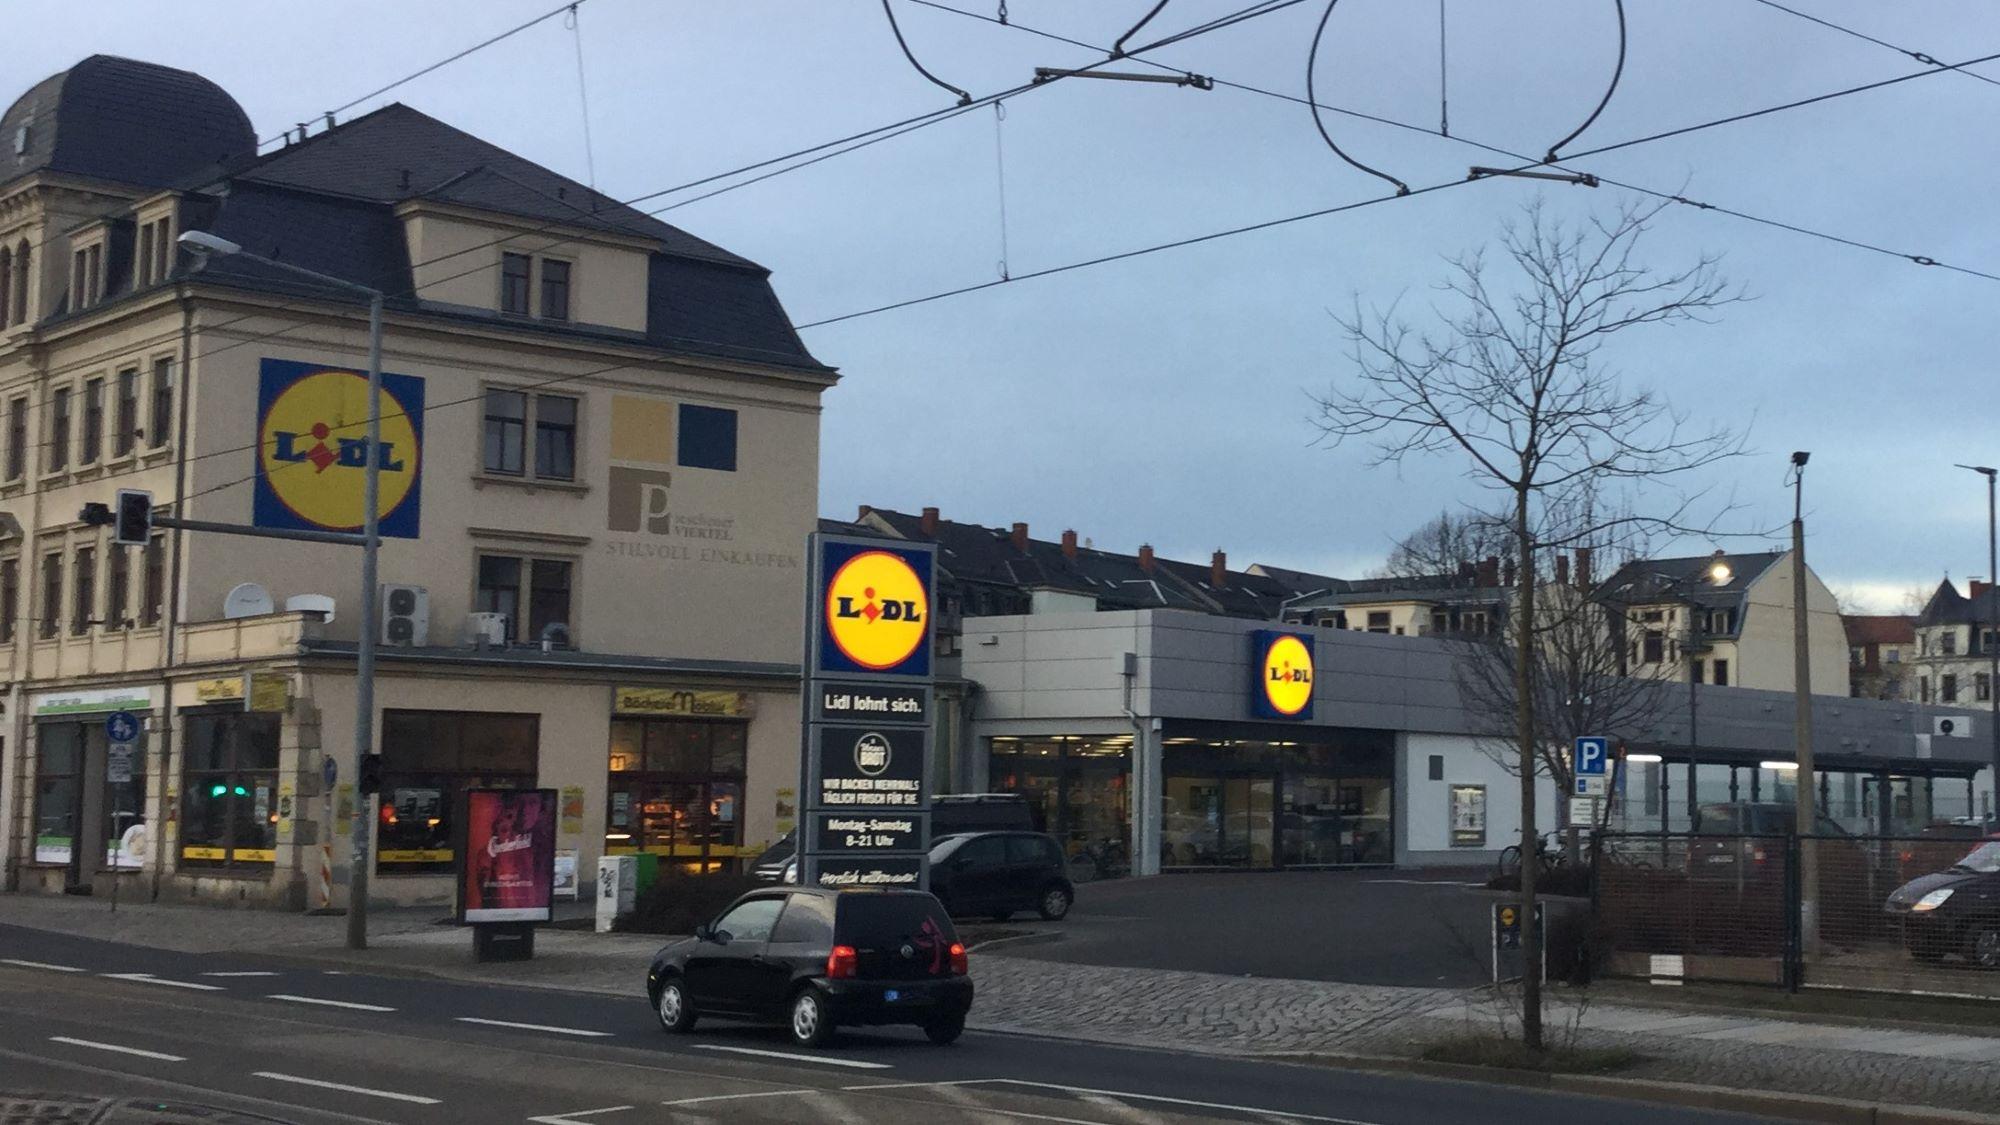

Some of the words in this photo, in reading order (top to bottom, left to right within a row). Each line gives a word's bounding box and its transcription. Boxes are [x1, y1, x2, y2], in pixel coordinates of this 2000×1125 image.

[674, 525, 734, 541] VIERTEL
[606, 541, 692, 561] STILVOLL
[700, 547, 799, 569] EINKAUFEN
[825, 694, 850, 710] Lidl
[853, 695, 888, 711] lohnt
[891, 697, 922, 713] sich.
[1582, 742, 1600, 770] P
[823, 779, 840, 789] WIR
[841, 779, 873, 790] BACKEN
[875, 780, 919, 790] MEHRMALS
[875, 835, 895, 846] Uhr
